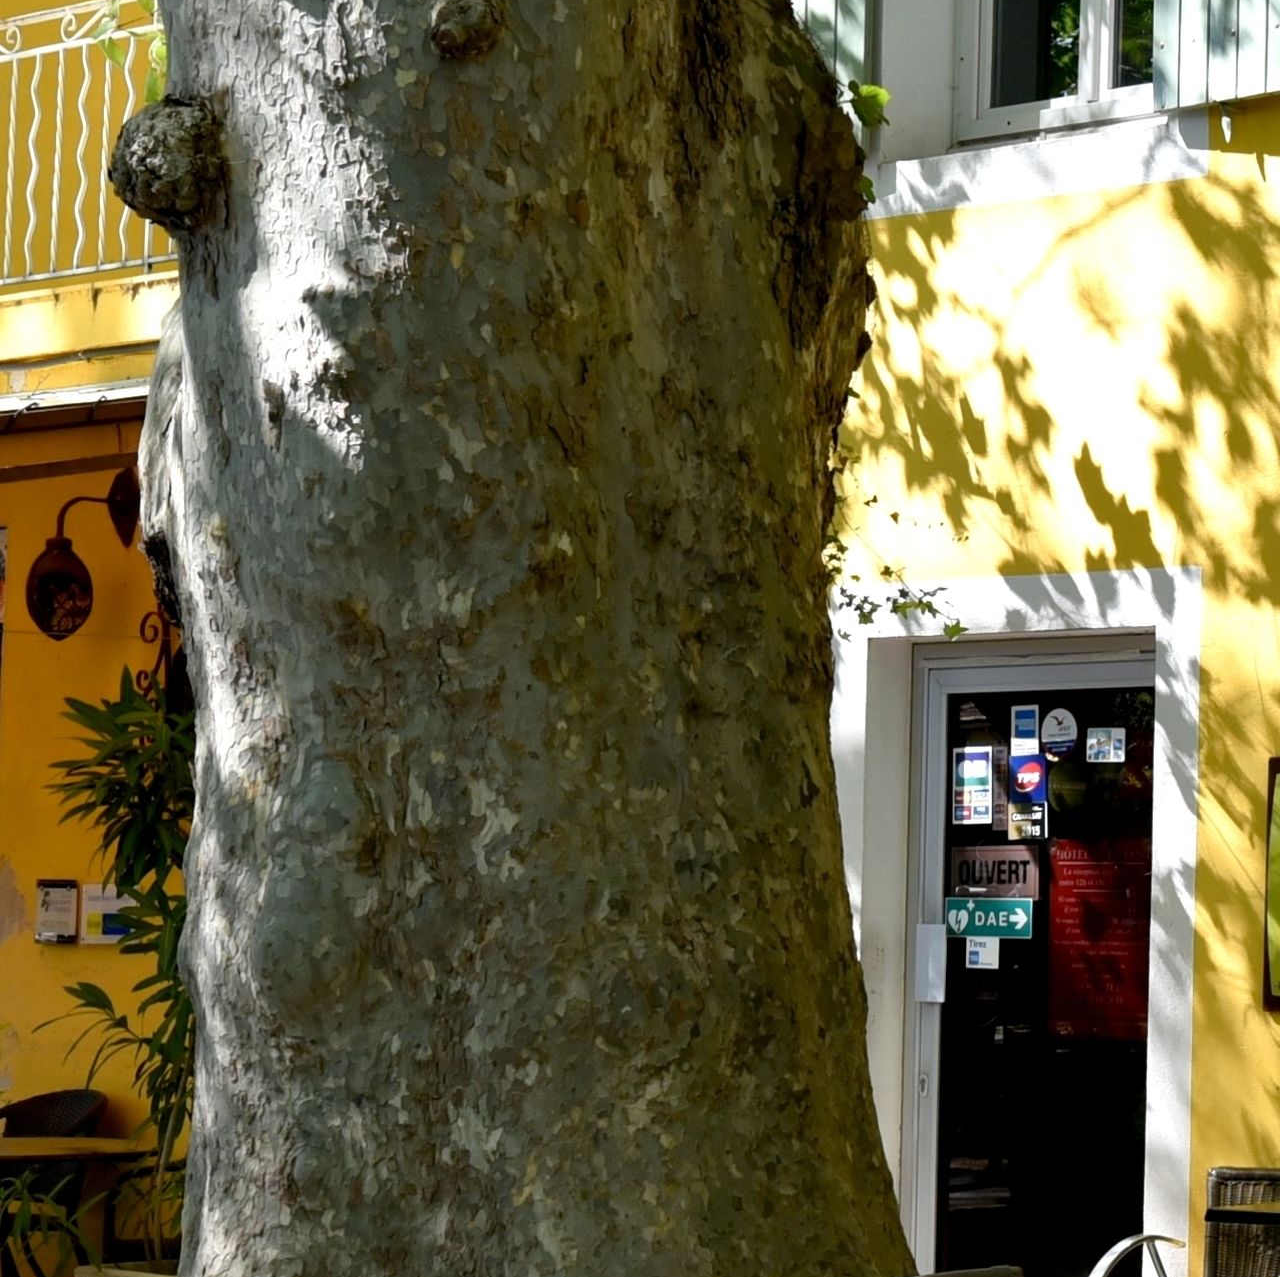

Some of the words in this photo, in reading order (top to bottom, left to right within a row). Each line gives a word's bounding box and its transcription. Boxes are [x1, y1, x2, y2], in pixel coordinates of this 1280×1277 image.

[958, 860, 1030, 885] OUVERT
[974, 911, 1009, 927] DAE
[968, 938, 987, 949] Tirez
